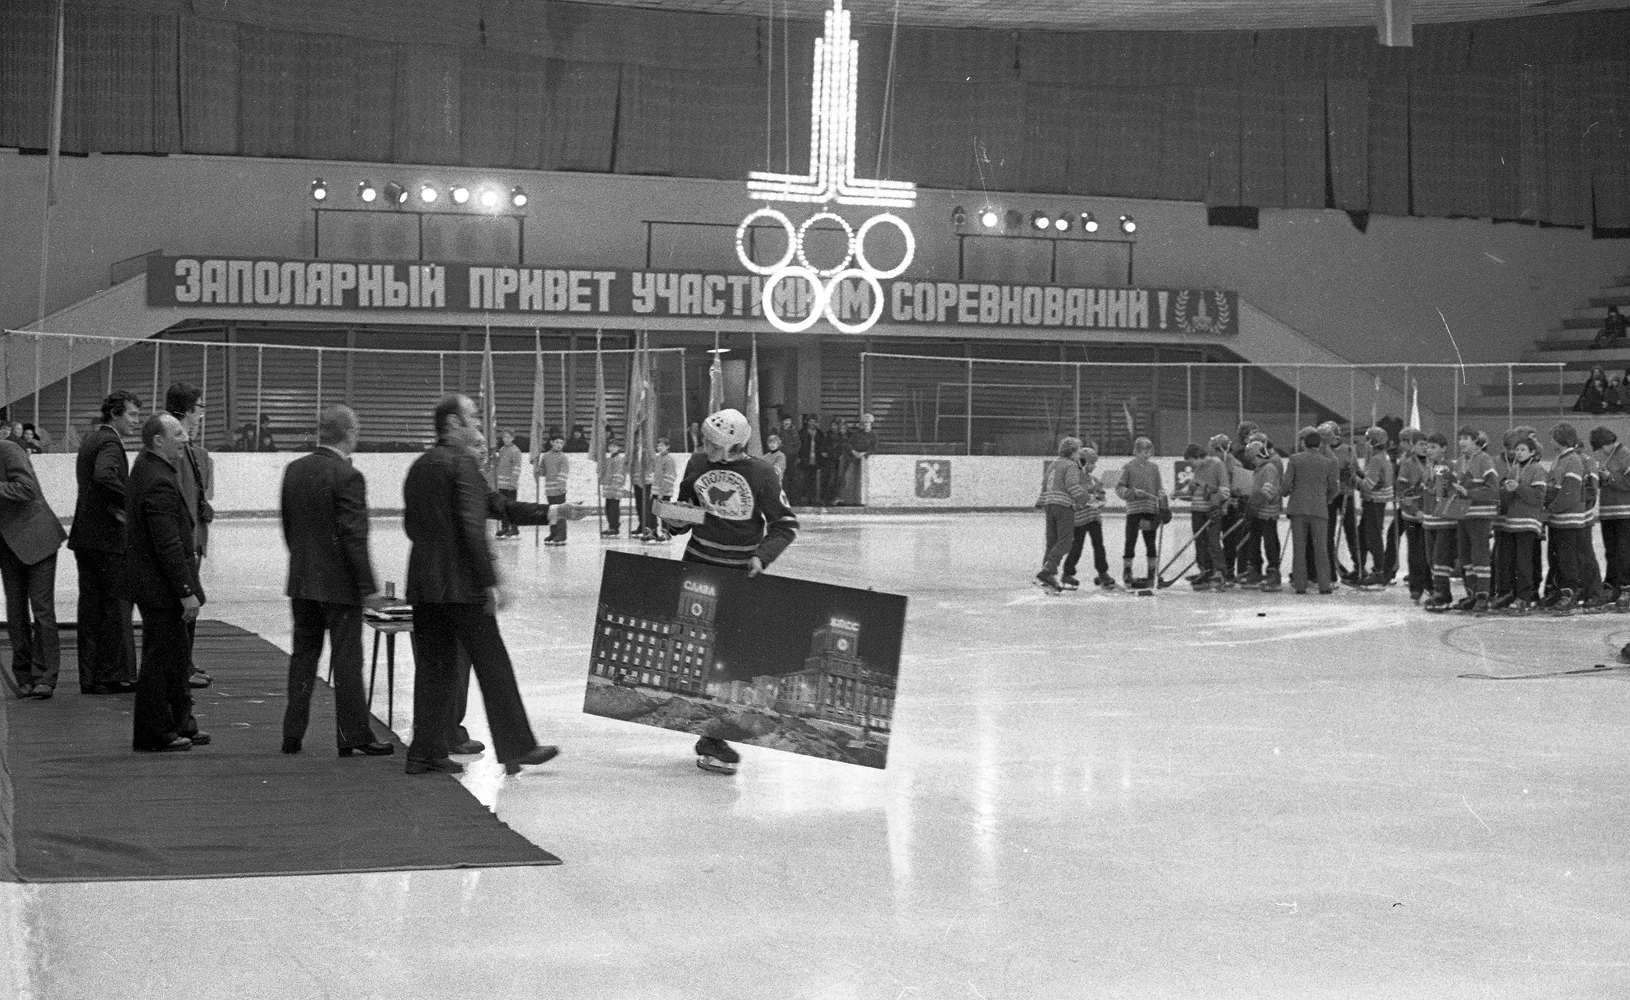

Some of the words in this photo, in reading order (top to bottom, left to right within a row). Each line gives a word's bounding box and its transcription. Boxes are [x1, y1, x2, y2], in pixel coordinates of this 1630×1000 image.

[175, 259, 445, 307] ЗАПОЛЯРНЫЙ
[469, 266, 616, 312] ПРИВЕТ
[698, 471, 752, 508] АПОЛЯРНИК
